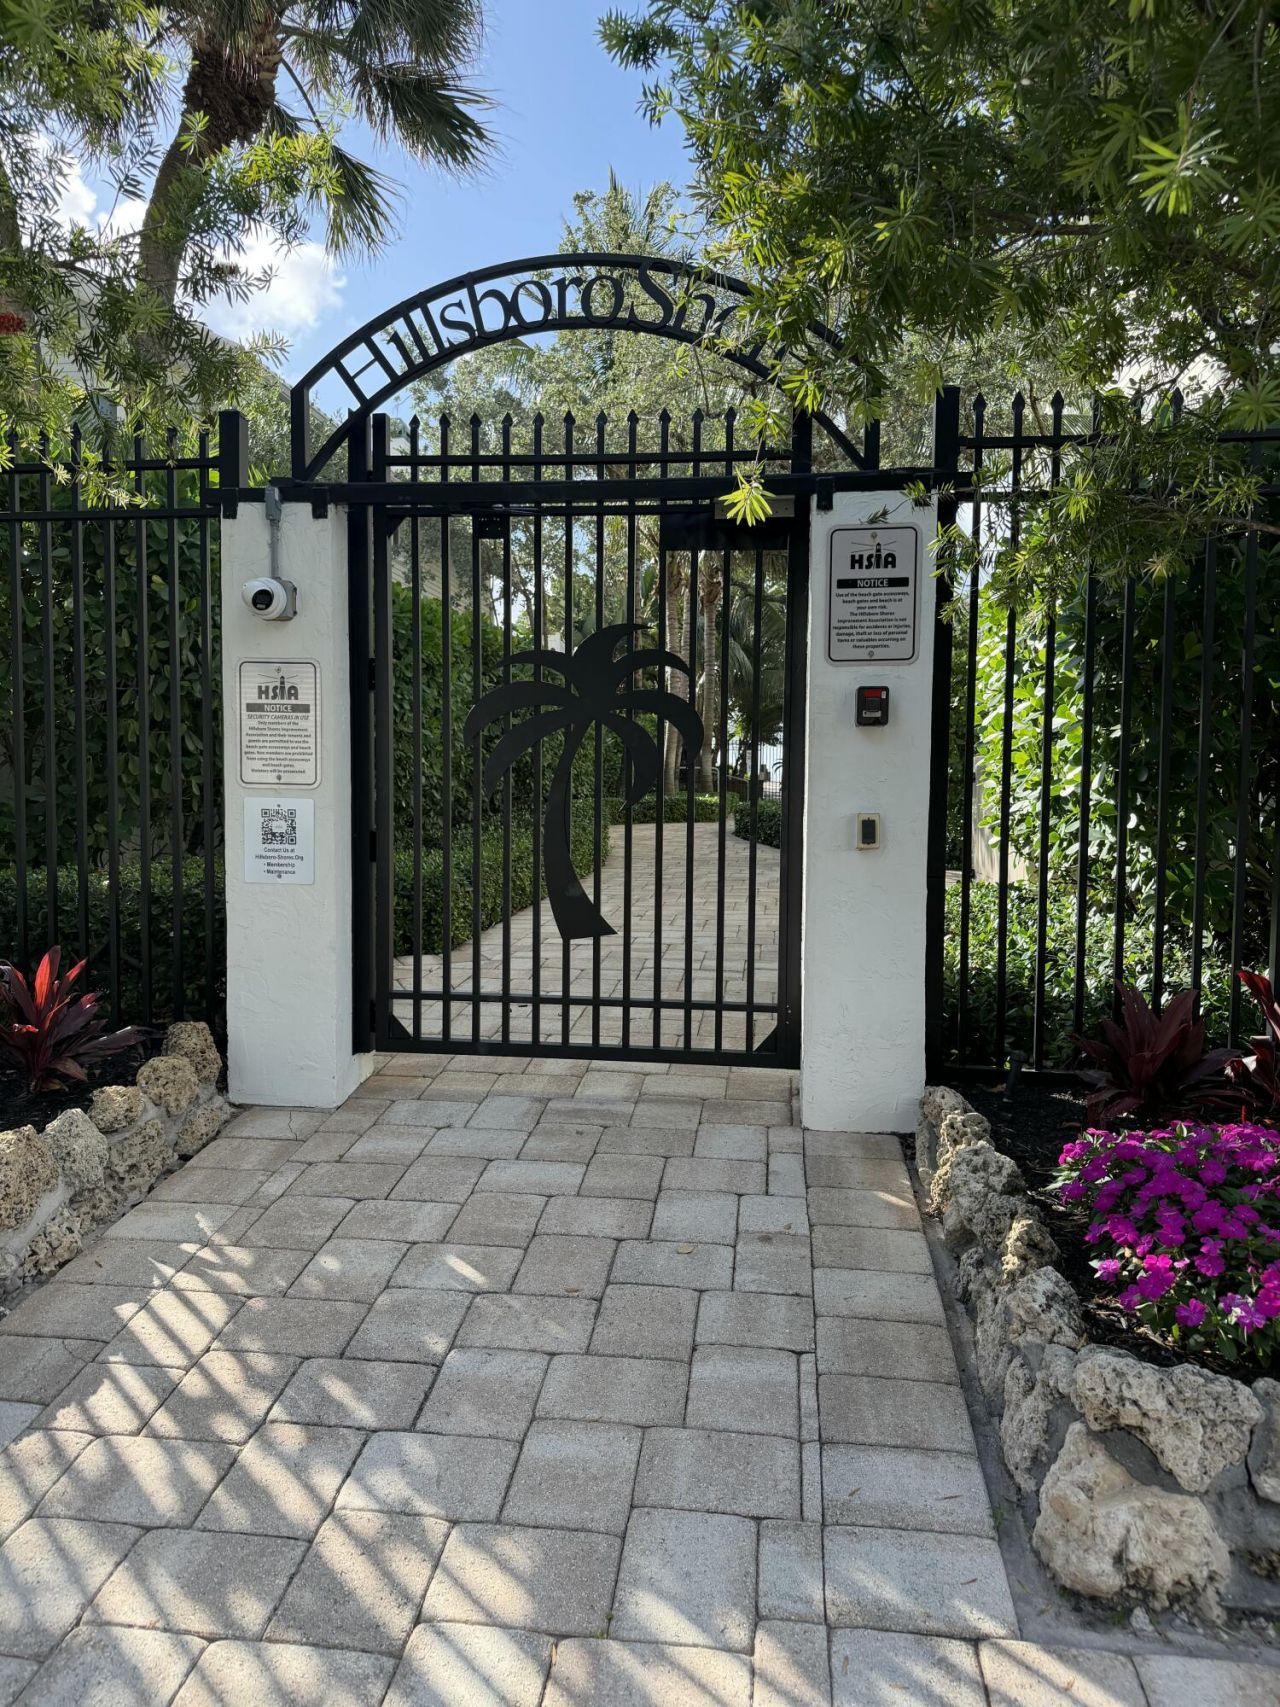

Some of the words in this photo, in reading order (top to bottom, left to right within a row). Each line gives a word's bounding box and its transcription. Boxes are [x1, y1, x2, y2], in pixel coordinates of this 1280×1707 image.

[850, 552, 897, 570] HSIA
[857, 579, 889, 587] NOTICE
[257, 685, 299, 701] HSIA
[264, 704, 293, 712] NOTICE
